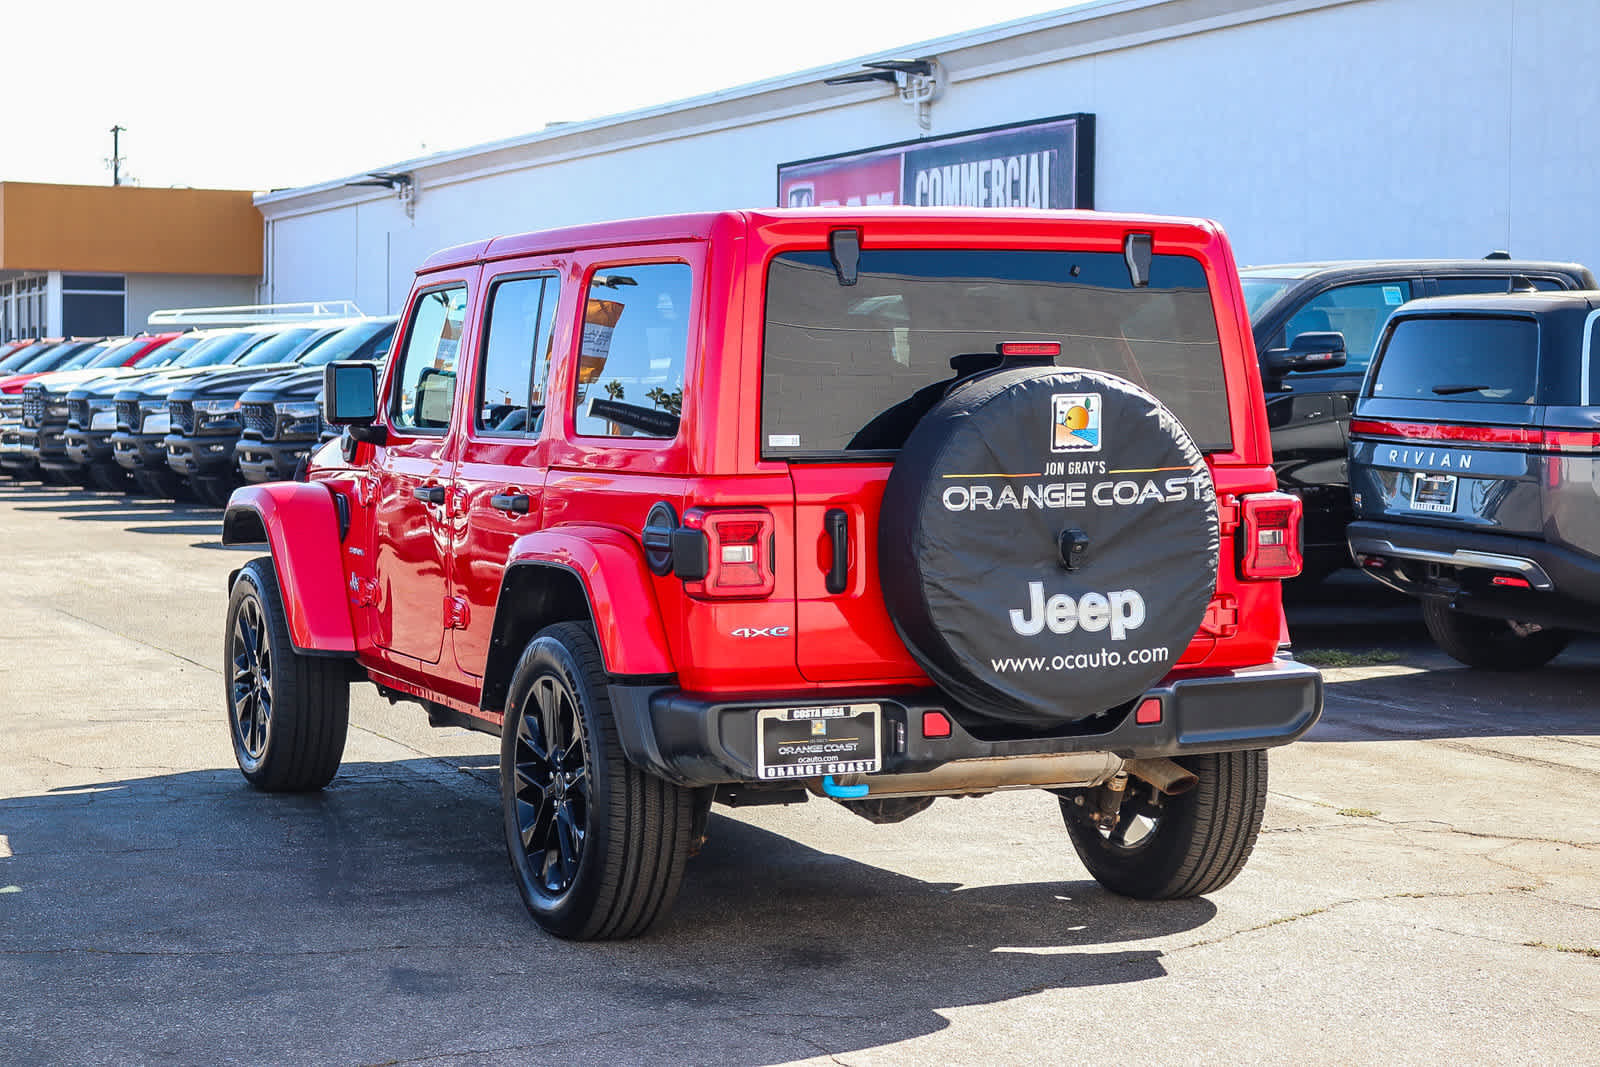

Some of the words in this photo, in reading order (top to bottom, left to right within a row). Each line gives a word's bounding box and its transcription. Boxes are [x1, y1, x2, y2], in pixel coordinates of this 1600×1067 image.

[916, 151, 1050, 208] COMMERCIAL
[1044, 462, 1064, 476] JON
[1068, 460, 1106, 475] GRAY'S
[1389, 449, 1472, 469] RIVIAN
[942, 482, 1087, 511] ORANGE
[1092, 477, 1202, 506] COAST
[1008, 581, 1146, 640] Jeep
[991, 647, 1169, 673] www.ocauto.com
[793, 708, 820, 719] COSTA
[822, 706, 845, 717] MESA
[778, 744, 823, 755] ORANGE
[824, 742, 859, 753] COAST
[798, 755, 839, 763] ocauto.com
[767, 764, 823, 777] ORANGE
[828, 761, 873, 773] COAST
